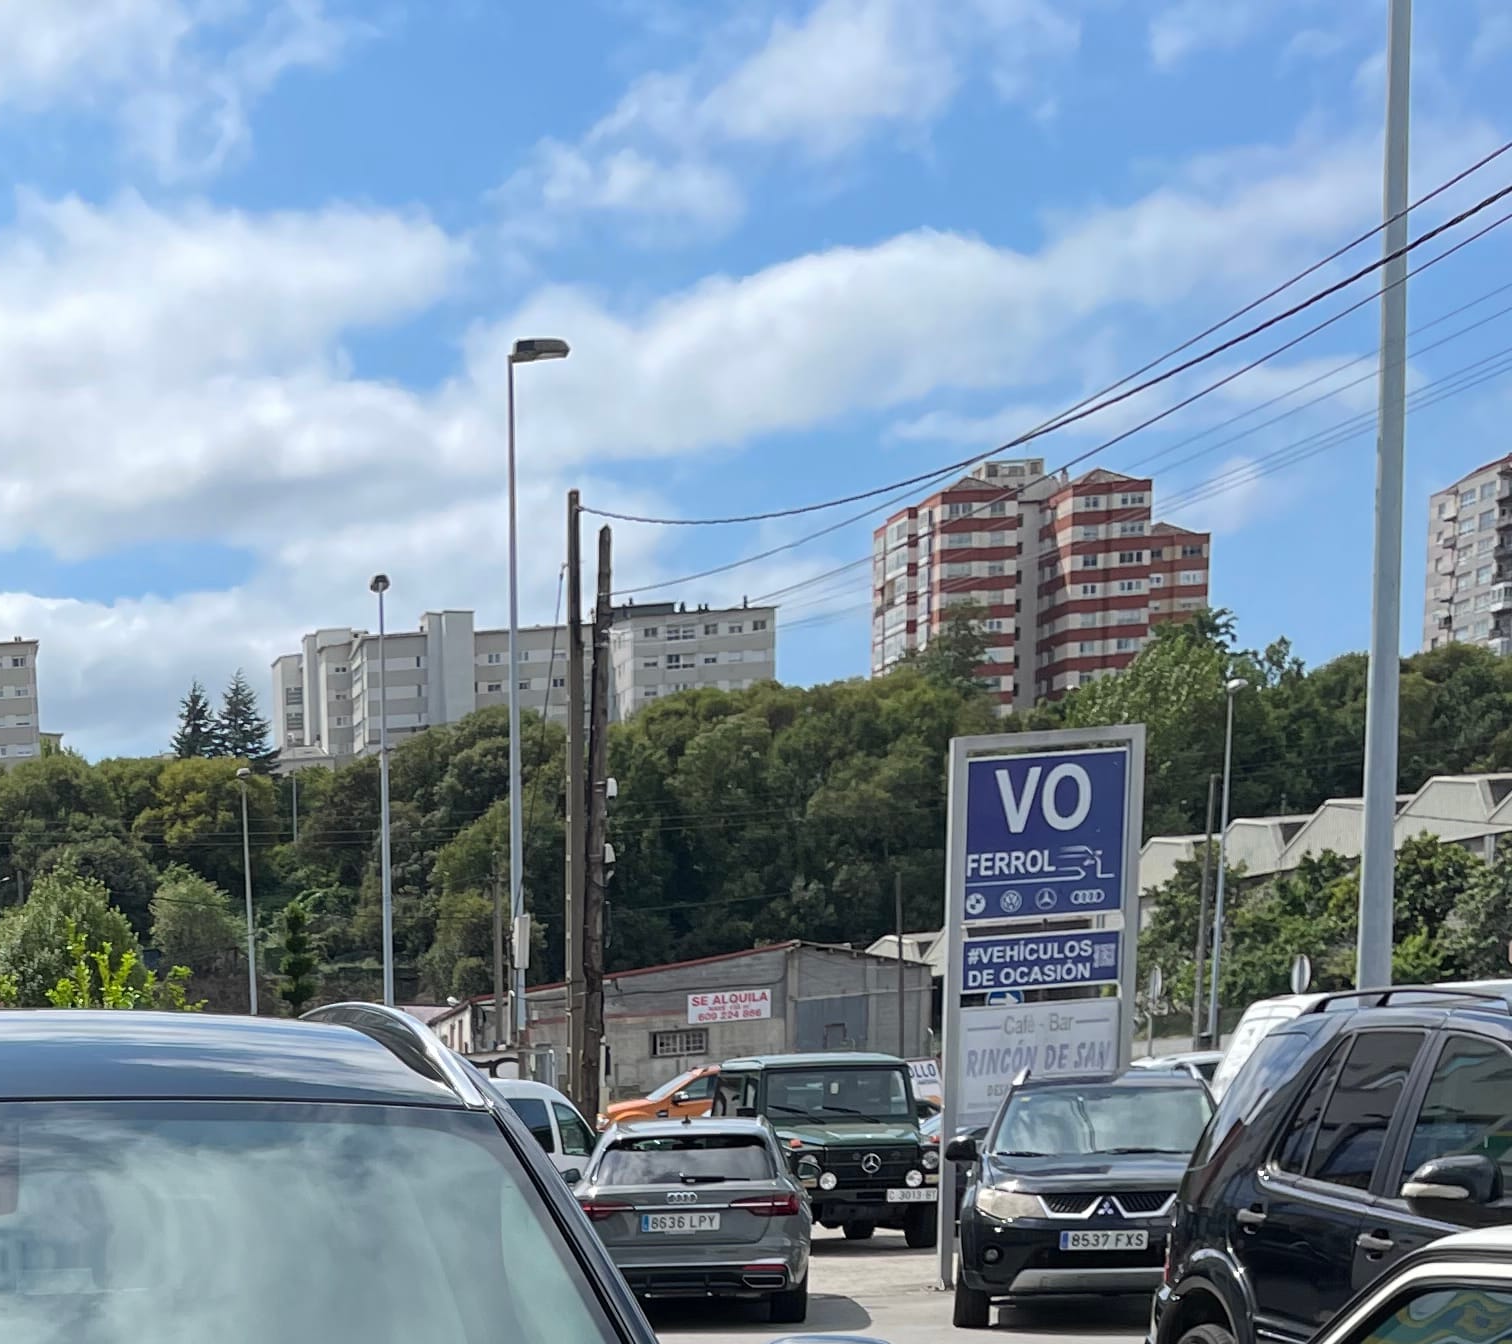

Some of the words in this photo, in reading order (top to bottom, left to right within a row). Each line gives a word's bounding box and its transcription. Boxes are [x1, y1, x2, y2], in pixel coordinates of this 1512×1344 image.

[995, 763, 1092, 833] VO
[966, 850, 1056, 877] FERROL
[968, 939, 1092, 965] #VEHÍCULOS
[968, 969, 994, 987] DE
[1000, 961, 1090, 984] OCASIÓN
[691, 996, 708, 1007] SE
[712, 992, 768, 1005] ALQUILA
[1004, 1015, 1035, 1035] Café
[1049, 1013, 1074, 1031] Bar
[966, 1040, 1038, 1077] RINCÓN
[1044, 1044, 1069, 1070] DE
[1074, 1041, 1112, 1071] SAN
[689, 1215, 715, 1228] LPY
[1071, 1233, 1110, 1247] 8537
[1115, 1233, 1144, 1247] FXS
